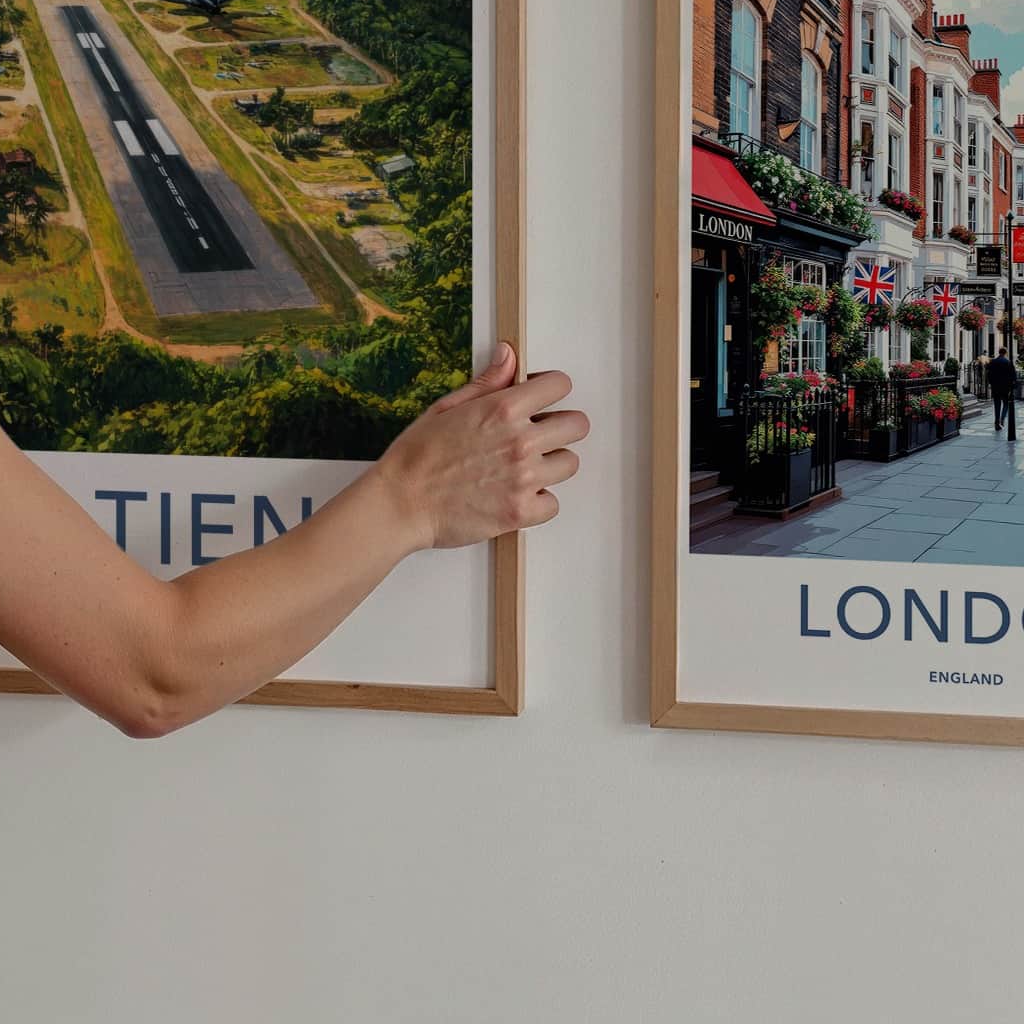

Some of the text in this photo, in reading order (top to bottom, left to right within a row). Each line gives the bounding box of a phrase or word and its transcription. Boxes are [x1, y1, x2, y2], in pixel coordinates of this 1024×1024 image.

[698, 213, 753, 241] LONDON
[799, 583, 1024, 645] LOND
[929, 670, 1004, 686] ENGLAND
